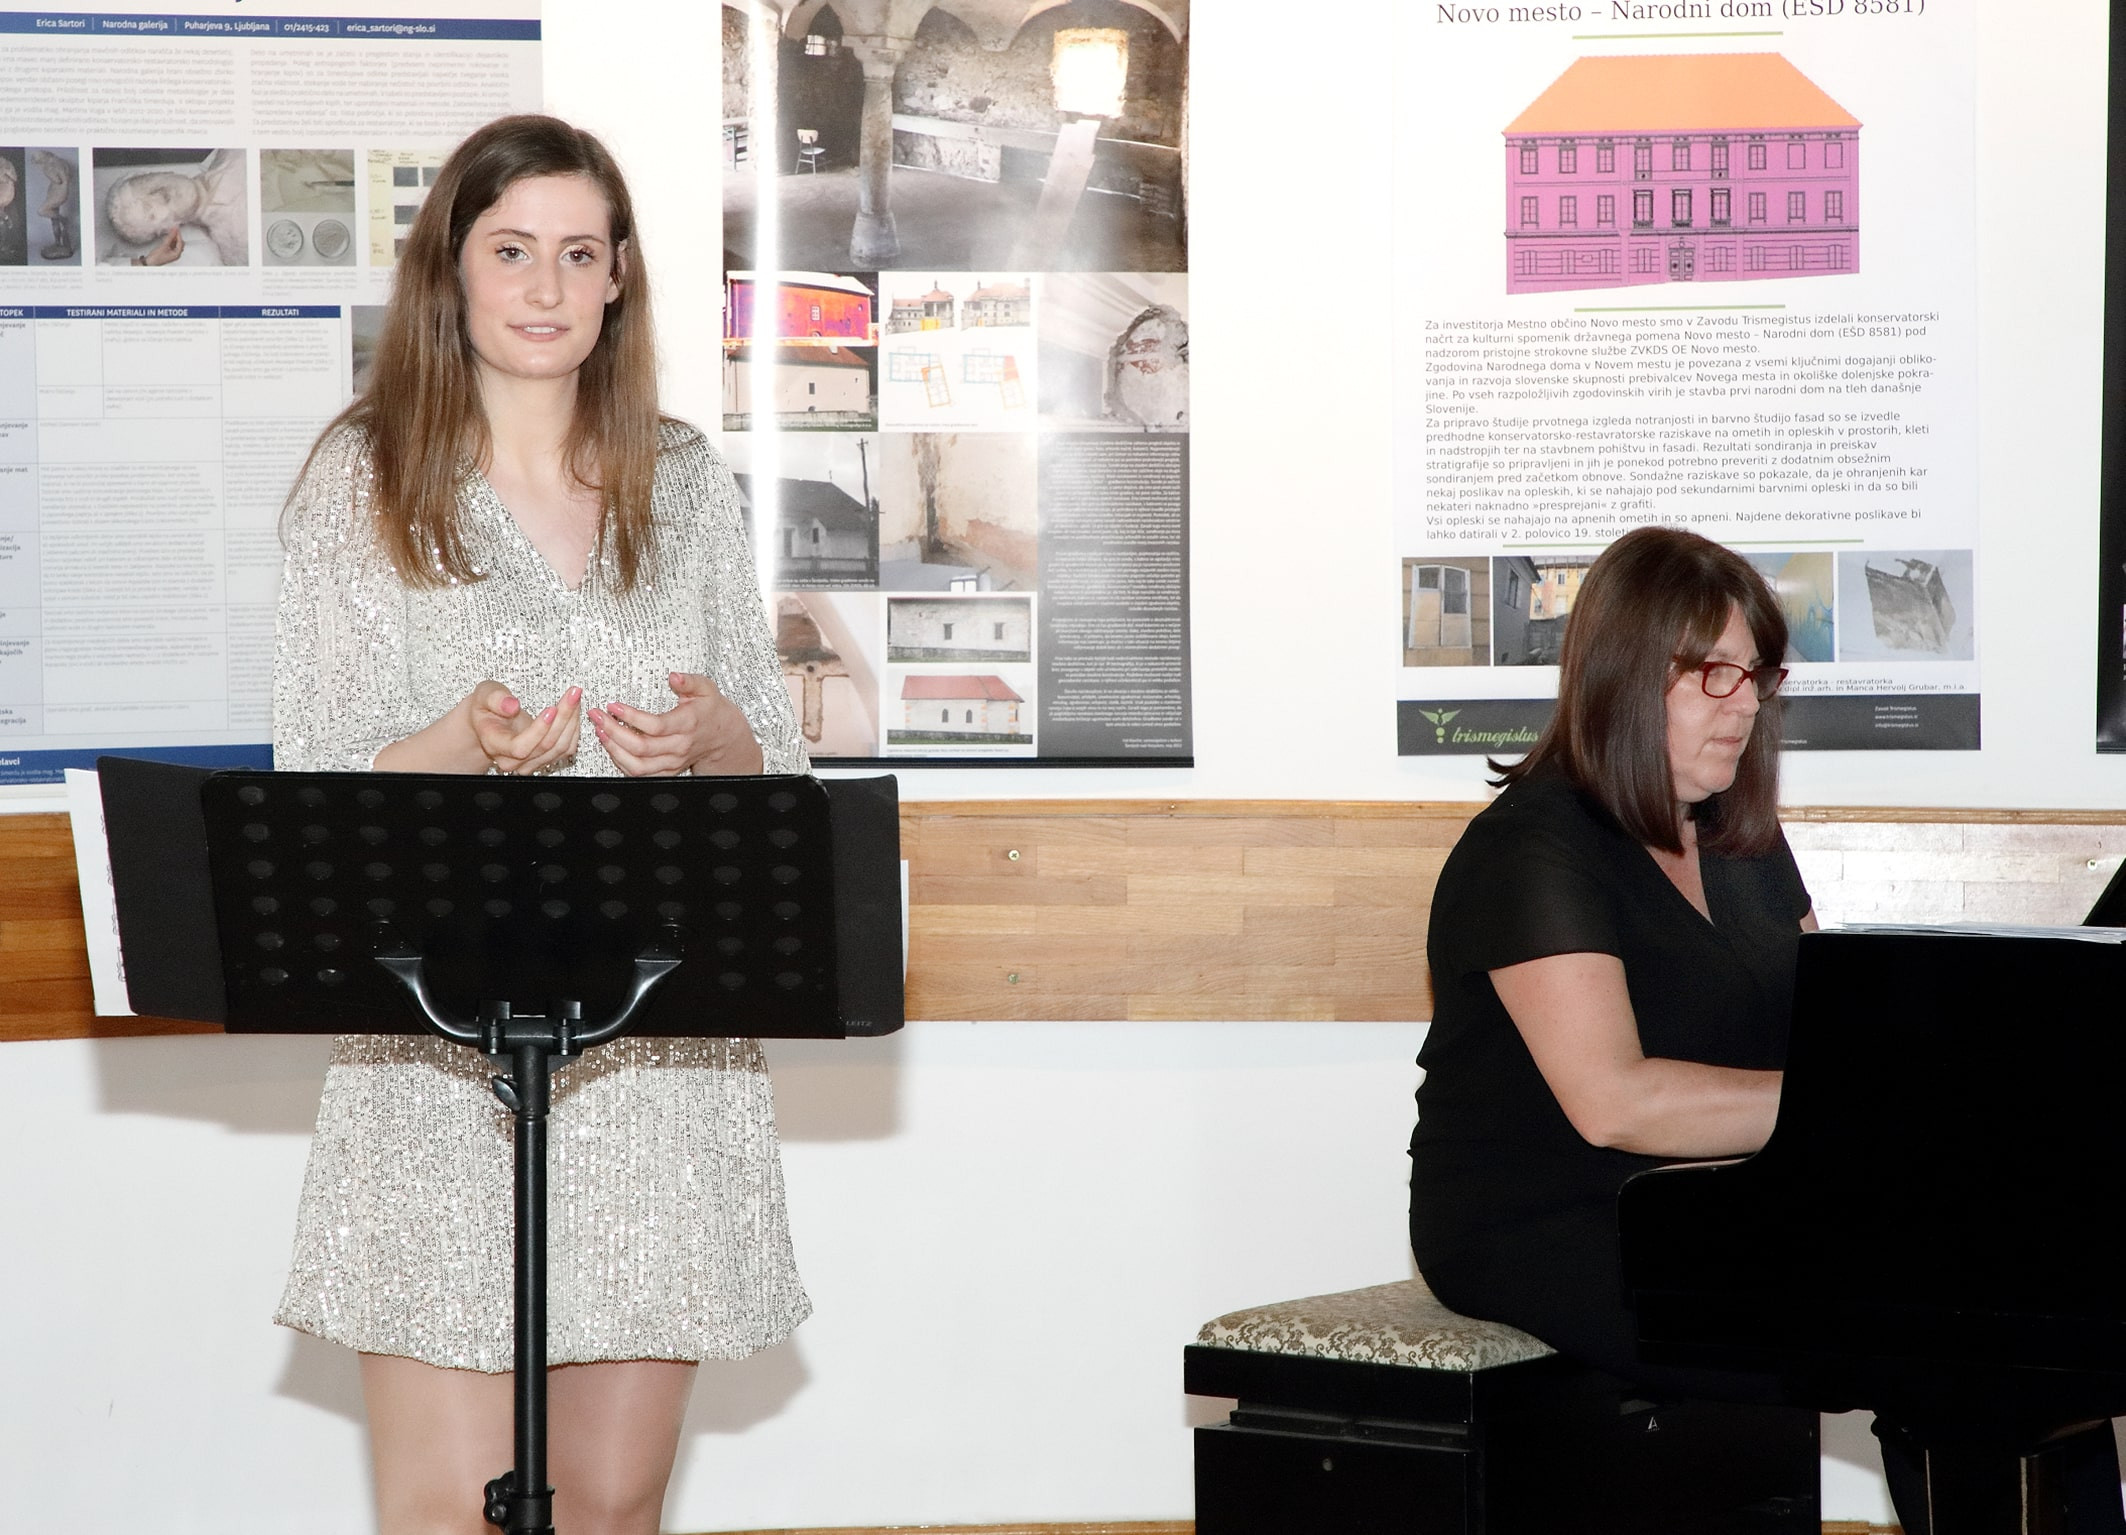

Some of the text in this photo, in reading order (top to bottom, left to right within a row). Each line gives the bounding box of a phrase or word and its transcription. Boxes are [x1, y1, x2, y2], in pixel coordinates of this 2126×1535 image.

[1436, 3, 1500, 24] Novo
[1508, 2, 1583, 22] mesto
[1611, 0, 1712, 21] Narodni
[1720, 0, 1773, 19] dom
[1854, 0, 1925, 16] 8581)
[36, 18, 85, 28] Erica Sartori
[103, 20, 168, 30] Narodna galerija
[185, 21, 223, 31] Puharjeva
[234, 21, 270, 32] Ljubljana
[284, 23, 330, 33] 01/2415-423
[347, 23, 436, 34] erica_sartori@ng-slo.si
[67, 309, 189, 317] TESTIRANI MATERIALI IN METODE
[262, 308, 300, 317] REZULTATI
[1424, 320, 1439, 330] Za
[1442, 319, 1503, 332] investitorja
[1507, 318, 1547, 329] Mestno
[1590, 317, 1618, 327] Novo
[1622, 316, 1656, 327] mesto
[1659, 318, 1683, 326] smo
[1696, 315, 1738, 325] Zavodu
[1741, 313, 1811, 327] Trismegistus
[1814, 313, 1853, 323] izdelali
[1857, 311, 1939, 322] konservatorski
[1472, 332, 1514, 343] kulturni
[1517, 331, 1570, 345] spomenik
[1635, 332, 1680, 343] pomena
[1684, 329, 1712, 340] Novo
[1715, 328, 1750, 339] mesto
[1763, 328, 1806, 338] Narodni
[1809, 327, 1834, 337] dom
[1868, 326, 1901, 339] 8581)
[1905, 326, 1926, 338] pod
[1425, 347, 1479, 358] nadzorom
[1482, 346, 1531, 359] pristojne
[1534, 345, 1588, 356] strokovne
[1630, 344, 1668, 354] ZVKDS
[1671, 344, 1687, 354] OE
[1690, 343, 1719, 354] Novo
[1722, 342, 1760, 353] mesto.
[1425, 361, 1483, 374] Zgodovina
[1486, 360, 1546, 373] Narodnega
[1549, 359, 1581, 370] doma
[1594, 358, 1633, 369] Novem
[1637, 358, 1671, 368] mestu
[1674, 358, 1685, 370] je
[1688, 359, 1741, 370] povezana
[1745, 359, 1751, 367] z
[1754, 356, 1788, 366] vsemi
[1844, 354, 1896, 367] dogajanji
[1899, 354, 1936, 364] obliko-
[1425, 375, 1455, 388] vanja
[1458, 375, 1468, 385] in
[1472, 374, 1511, 388] razvoja
[1514, 374, 1569, 384] slovenske
[1572, 373, 1625, 386] skupnosti
[1628, 372, 1692, 385] prebivalcev
[1696, 371, 1738, 384] Novega
[1741, 370, 1776, 381] mesta
[1779, 370, 1790, 380] in
[1840, 368, 1894, 382] dolenjske
[1897, 368, 1933, 381] pokra-
[1425, 390, 1448, 402] jine.
[1452, 389, 1465, 399] Po
[1468, 389, 1494, 399] vseh
[1572, 386, 1644, 400] zgodovinskih
[1647, 386, 1672, 396] virih
[1675, 386, 1685, 398] je
[1688, 385, 1726, 396] stavba
[1729, 384, 1751, 397] prvi
[1754, 384, 1796, 394] narodni
[1799, 383, 1825, 394] dom
[1845, 383, 1867, 393] tleh
[1425, 403, 1478, 416] Slovenije.
[1426, 500, 1471, 511] nekateri
[1474, 500, 1529, 510] naknadno
[1610, 501, 1617, 509] z
[1619, 498, 1655, 511] grafiti.
[1426, 515, 1443, 525] Vsi
[1446, 514, 1484, 527] opleski
[1504, 514, 1551, 527] nahajajo
[1571, 513, 1616, 526] apnenih
[1619, 512, 1658, 523] ometih
[1661, 512, 1673, 522] in
[1673, 514, 1687, 522] so
[1690, 511, 1731, 524] apneni.
[1735, 510, 1782, 523] Najdene
[1784, 509, 1851, 520] dekorativne
[1854, 508, 1907, 522] poslikave
[1911, 508, 1921, 518] bi
[1427, 529, 1456, 539] lahko
[1459, 528, 1497, 539] datirali
[1511, 528, 1521, 538] 2.
[1525, 527, 1571, 540] polovico
[1575, 527, 1592, 537] 19.
[1452, 726, 1539, 748] trismegistus
